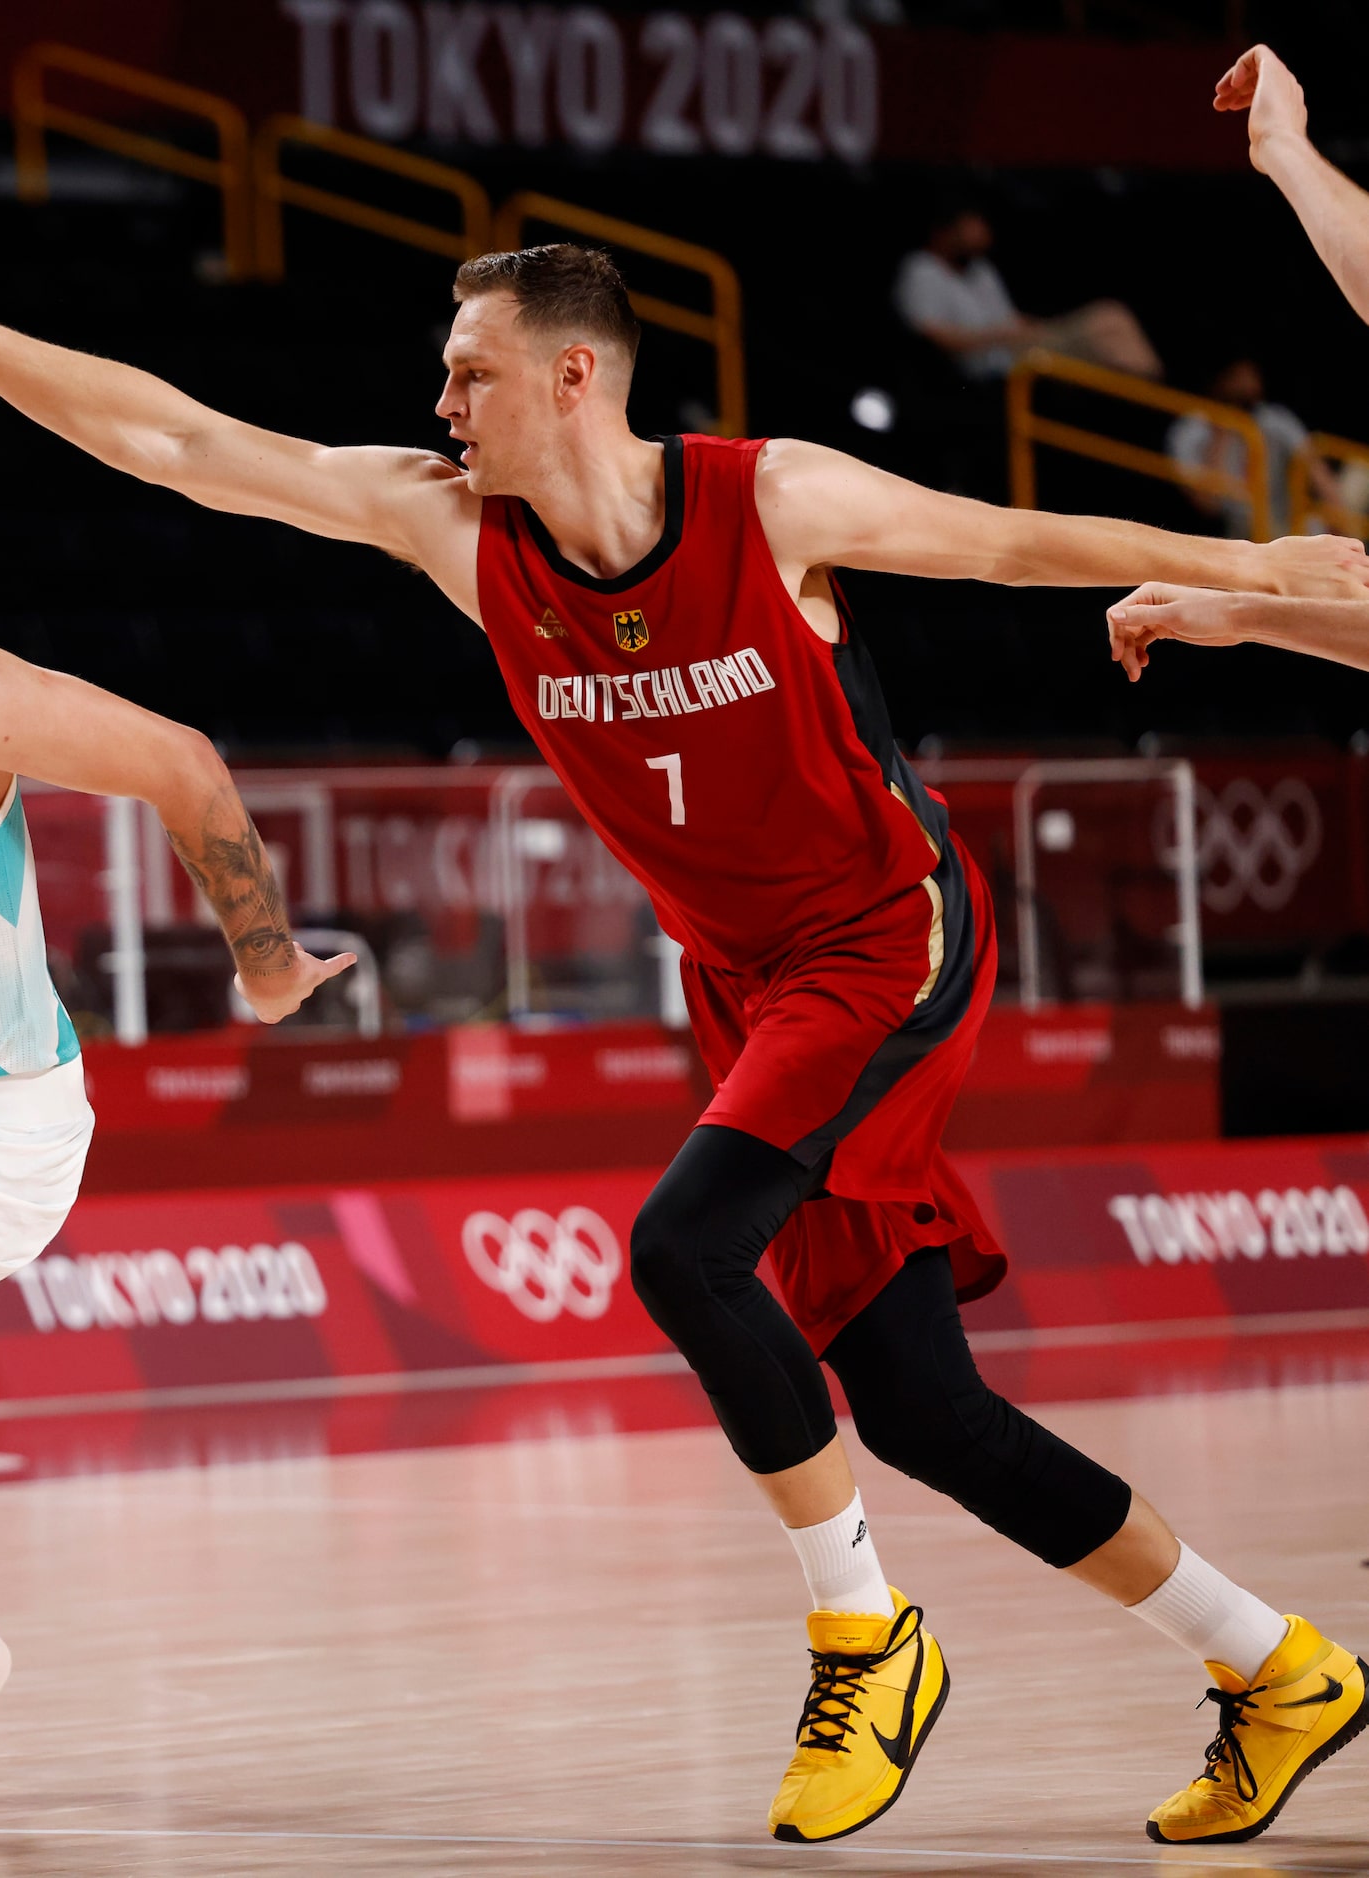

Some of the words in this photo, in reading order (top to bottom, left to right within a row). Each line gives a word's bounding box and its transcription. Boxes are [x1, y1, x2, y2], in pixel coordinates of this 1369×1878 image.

[281, 0, 626, 152] TOKYO
[640, 10, 879, 158] 2020
[537, 647, 777, 722] DEUTSCHLAND
[645, 752, 686, 826] 7
[1108, 1191, 1266, 1265] TOKYO
[1257, 1183, 1369, 1258] 2020
[12, 1248, 197, 1334] TOKYO
[185, 1241, 329, 1324] 2020
